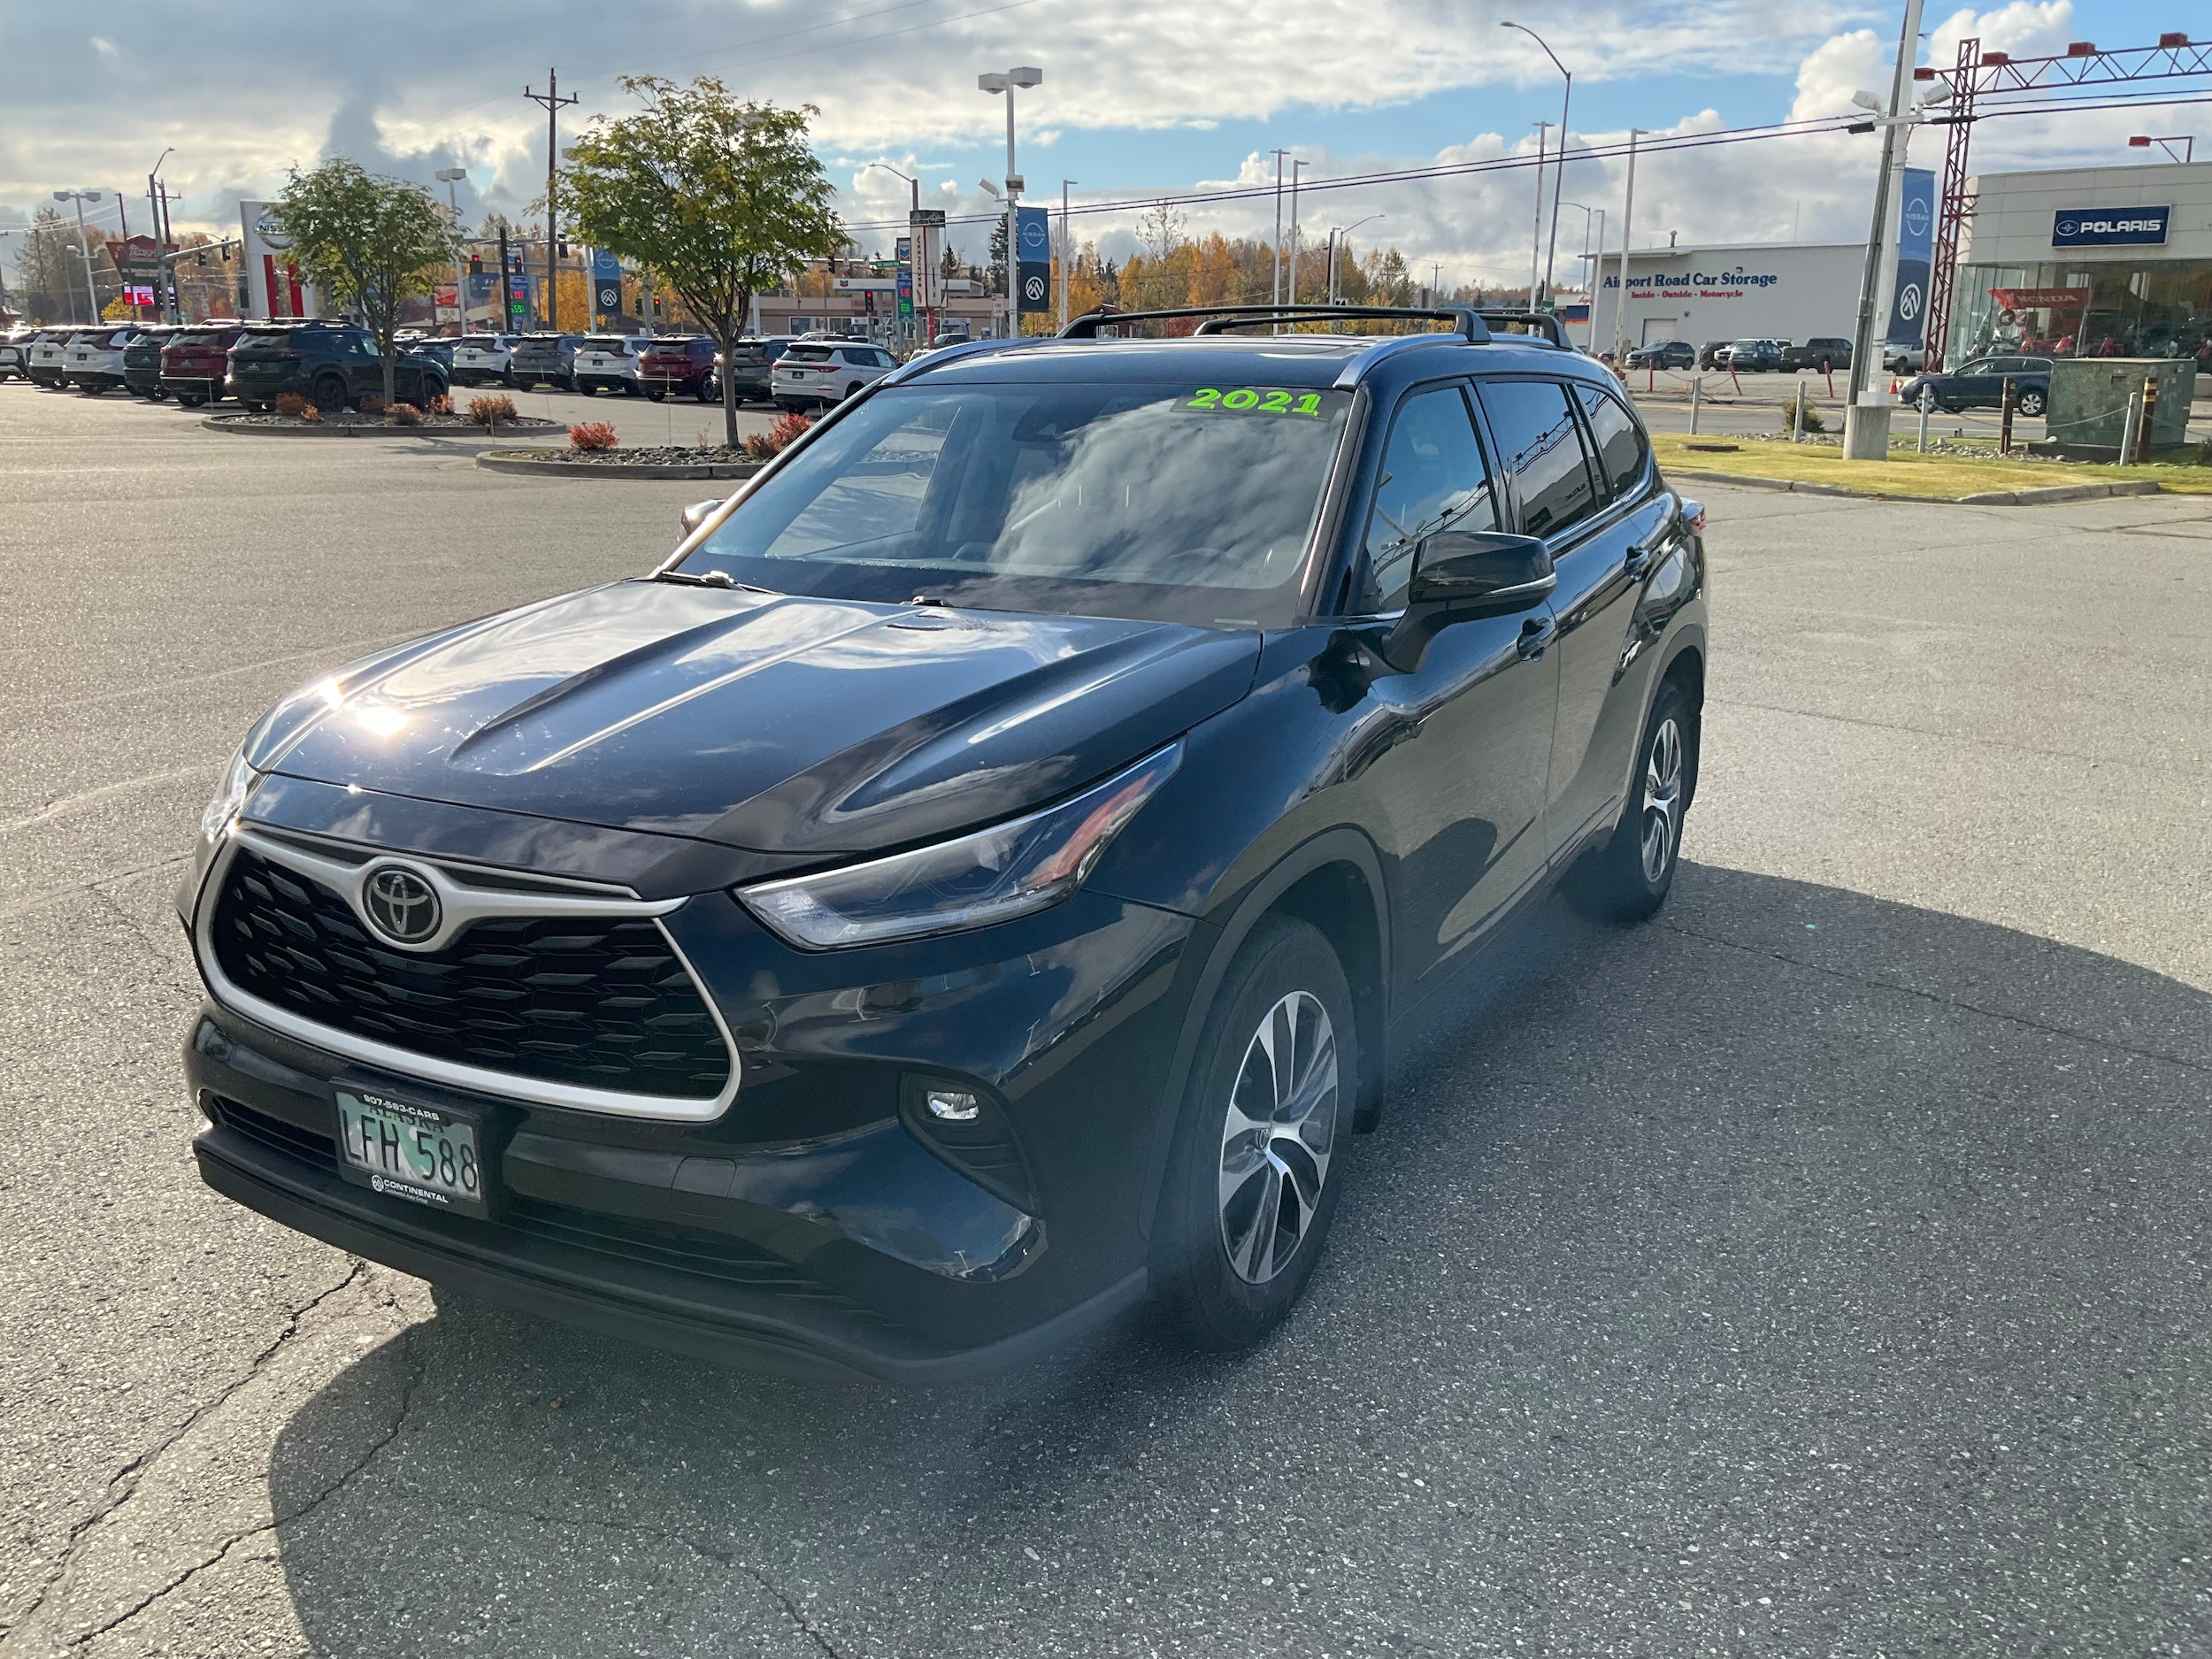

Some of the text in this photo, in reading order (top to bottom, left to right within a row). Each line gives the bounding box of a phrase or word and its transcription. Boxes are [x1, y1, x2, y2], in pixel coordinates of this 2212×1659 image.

[1905, 212, 1929, 221] NISSAN
[2080, 219, 2162, 234] POLARIS
[1654, 273, 1691, 287] Road
[1693, 273, 1717, 286] Car
[1720, 272, 1778, 288] Storage
[1187, 388, 1322, 417] 2021
[342, 1110, 478, 1192] LFH 588
[383, 1179, 449, 1203] CONTINENTAL
